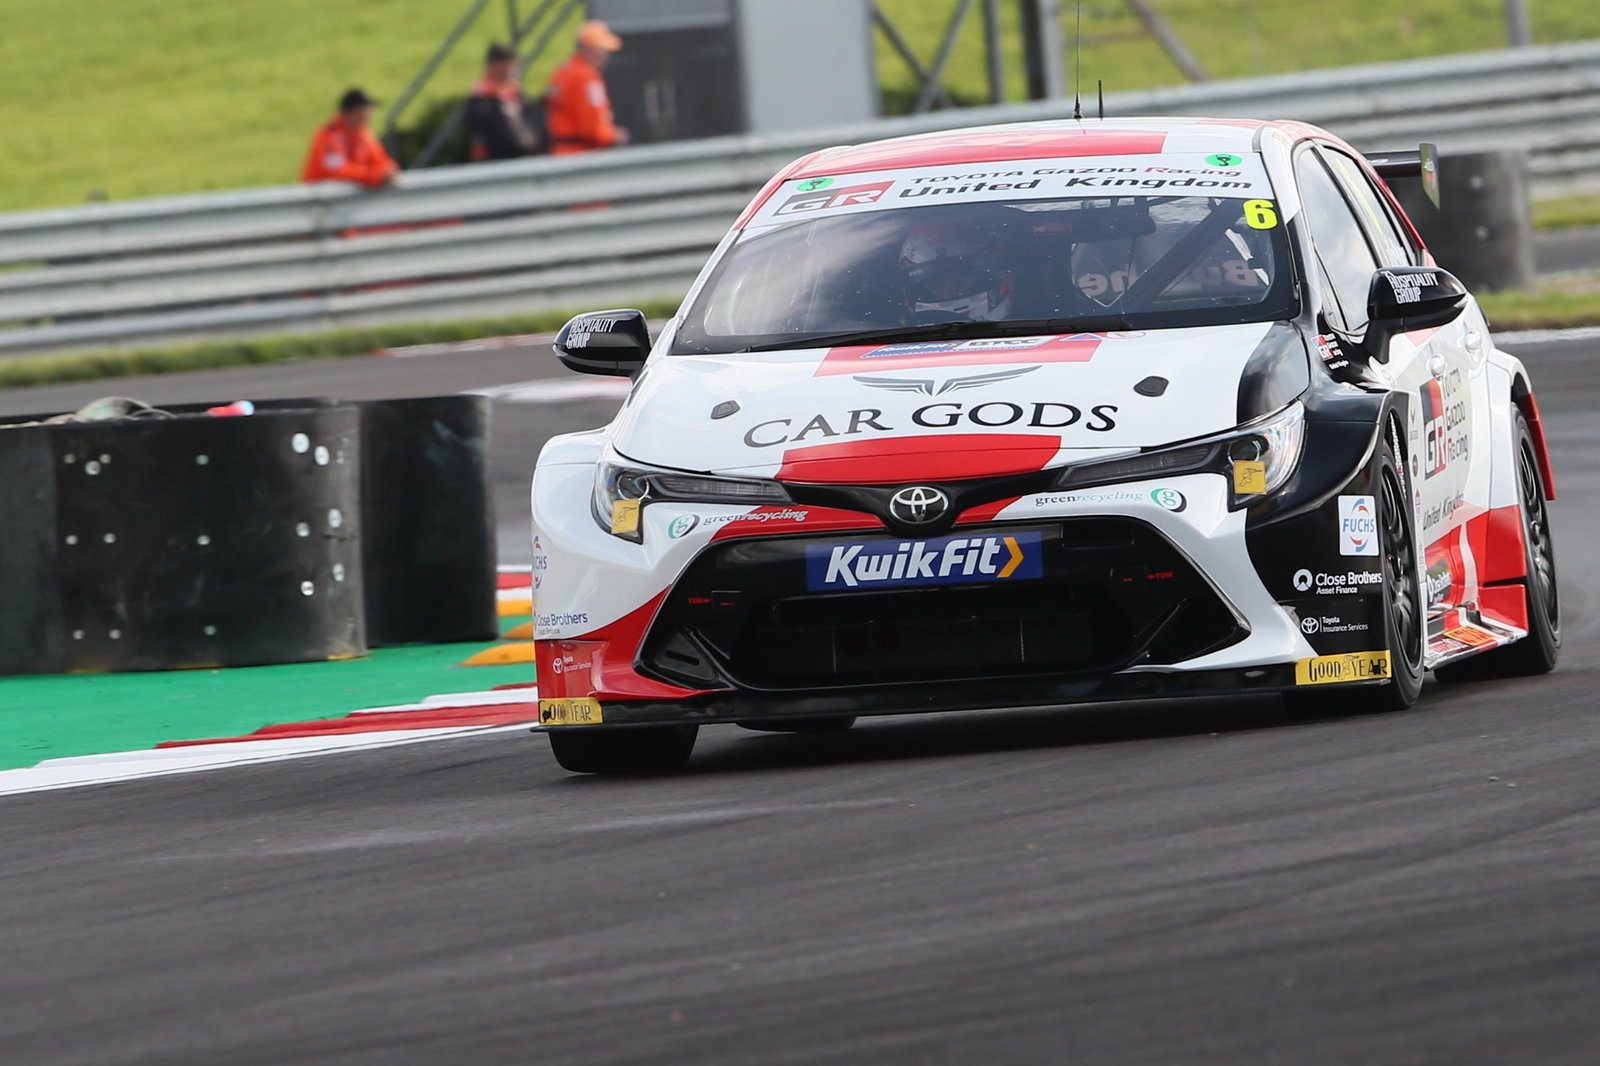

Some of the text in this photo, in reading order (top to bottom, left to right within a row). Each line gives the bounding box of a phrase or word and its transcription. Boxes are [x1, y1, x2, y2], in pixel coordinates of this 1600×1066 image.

[910, 166, 1243, 184] TOYOTA GAZOO Racing
[898, 176, 1253, 198] United Kingdom
[774, 184, 886, 216] GR
[1242, 199, 1278, 230] 6
[1394, 286, 1422, 304] GROUP
[566, 333, 591, 349] GROUP
[743, 402, 1118, 448] CAR GODS
[1424, 415, 1447, 480] GR
[1447, 431, 1469, 463] Racing
[1342, 517, 1376, 533] FUCHS
[1315, 570, 1383, 586] Close Brothers
[1316, 585, 1358, 595] Asset Finance
[550, 612, 588, 626] Brothers
[1322, 616, 1340, 625] Toyota
[1322, 623, 1369, 633] Insurance Services
